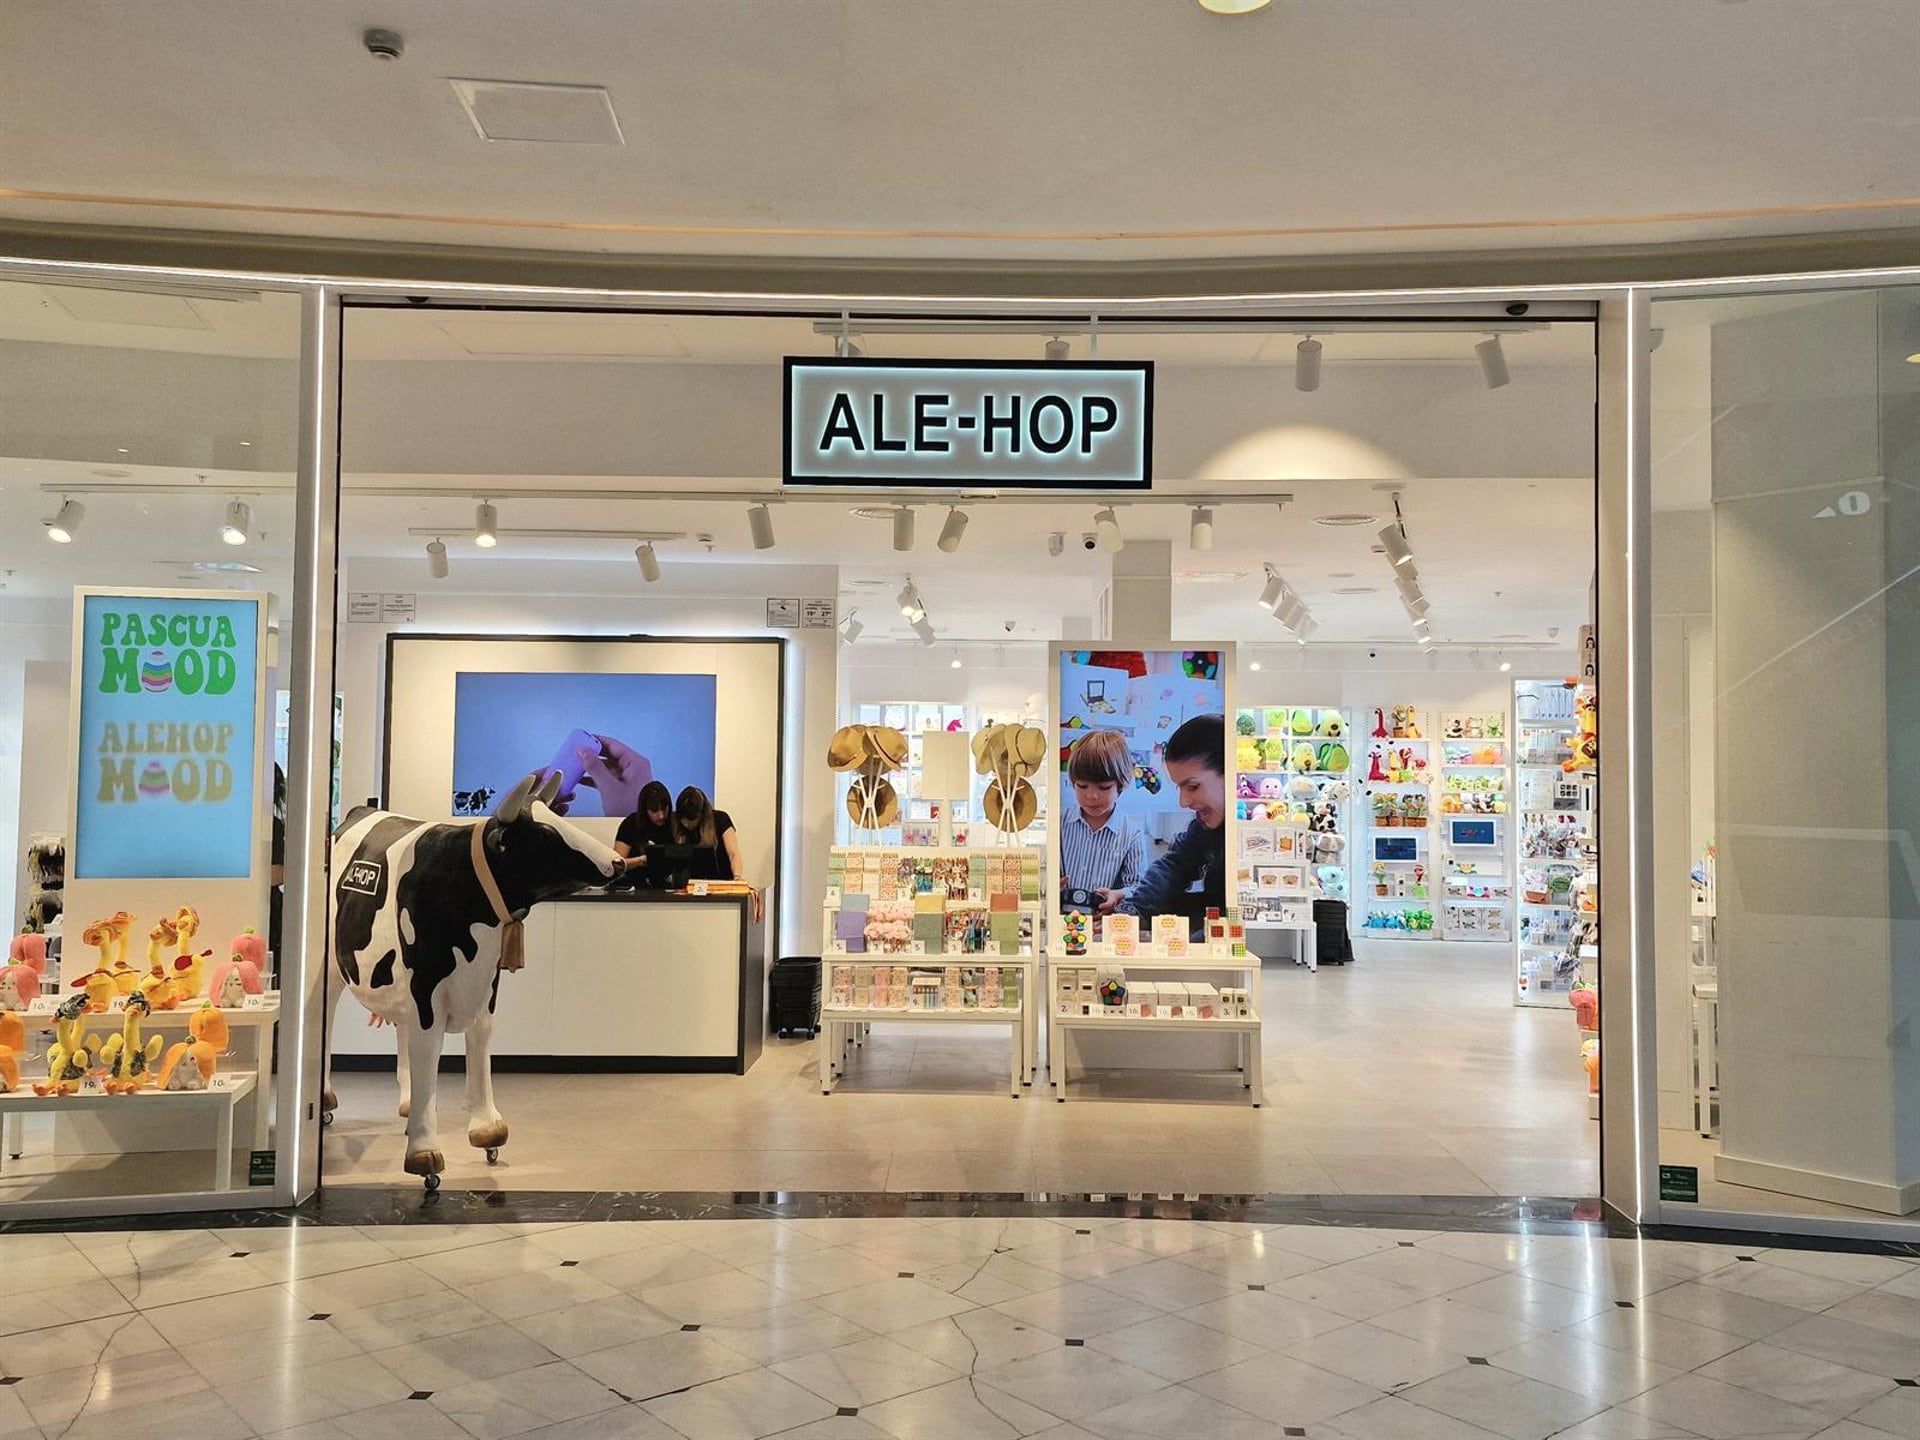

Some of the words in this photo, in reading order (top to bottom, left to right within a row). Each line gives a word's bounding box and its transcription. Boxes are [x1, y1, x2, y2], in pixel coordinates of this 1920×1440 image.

[818, 393, 1118, 454] ALE-HOP
[100, 613, 237, 647] PASCUA
[98, 721, 234, 754] ALEHOP
